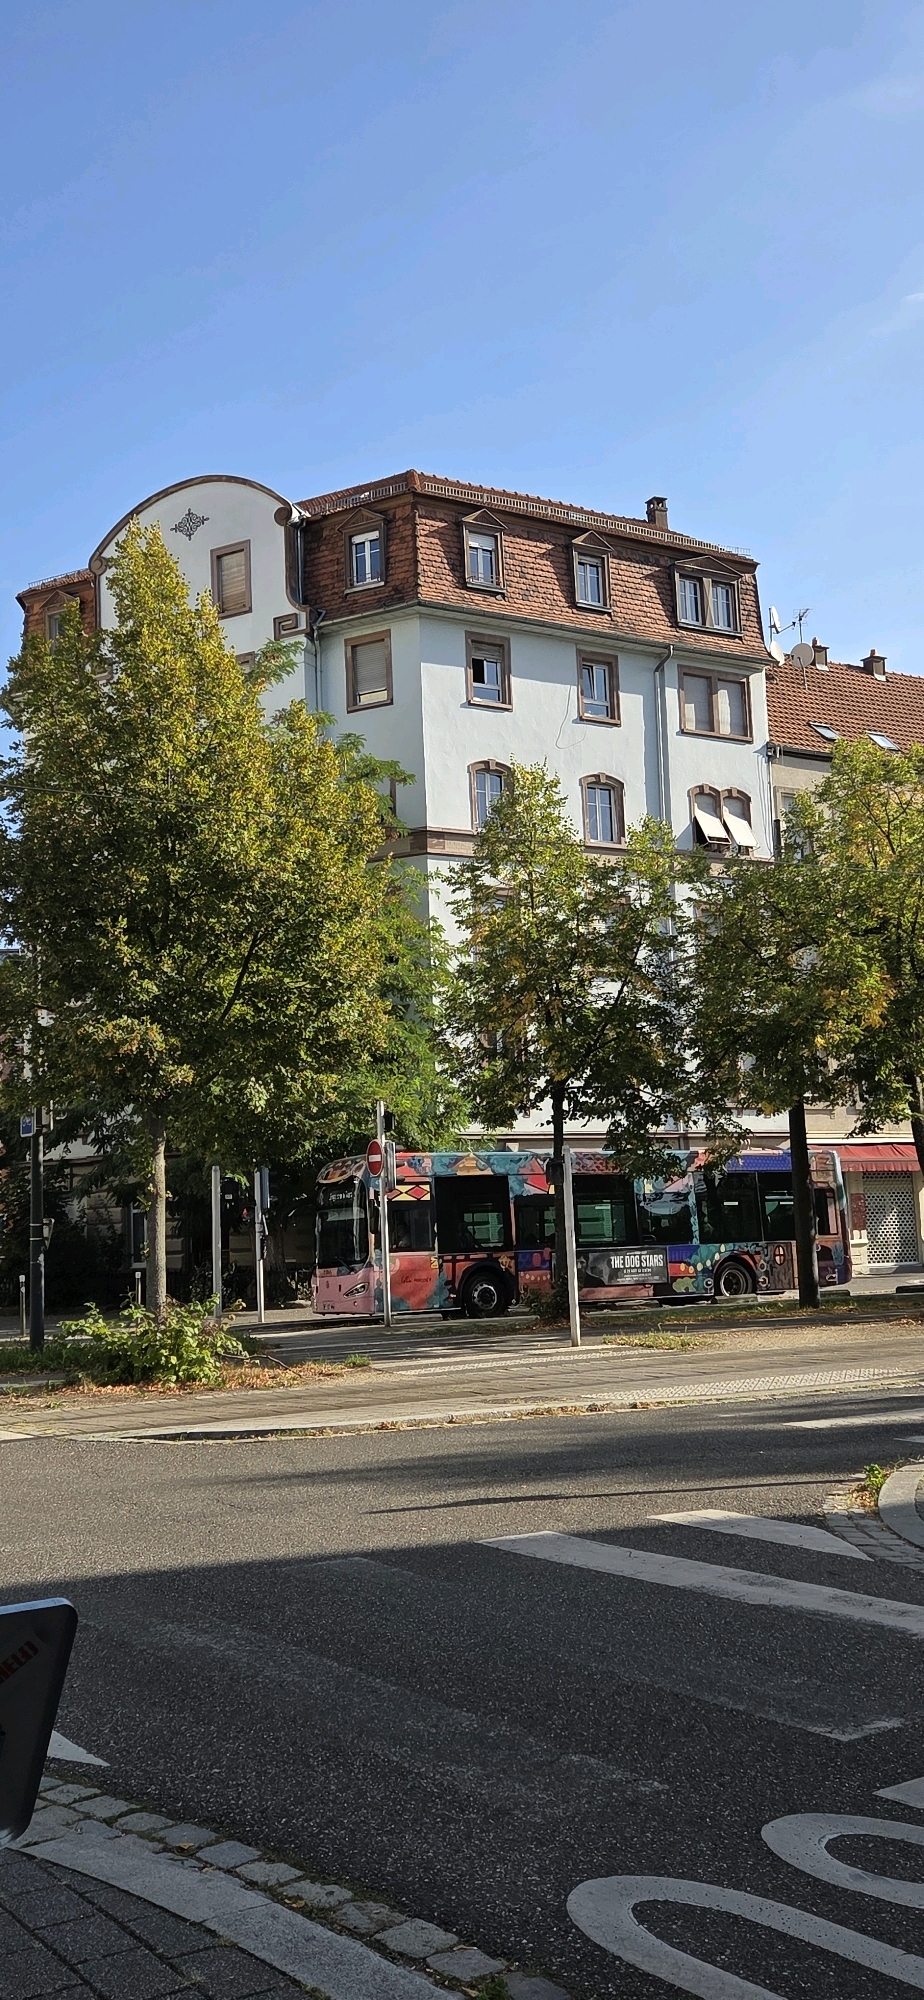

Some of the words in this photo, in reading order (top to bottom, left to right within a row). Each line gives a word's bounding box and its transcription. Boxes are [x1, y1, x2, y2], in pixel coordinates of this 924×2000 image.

[610, 1255, 624, 1269] THE
[624, 1255, 640, 1268] DOG
[641, 1254, 664, 1267] STARS
